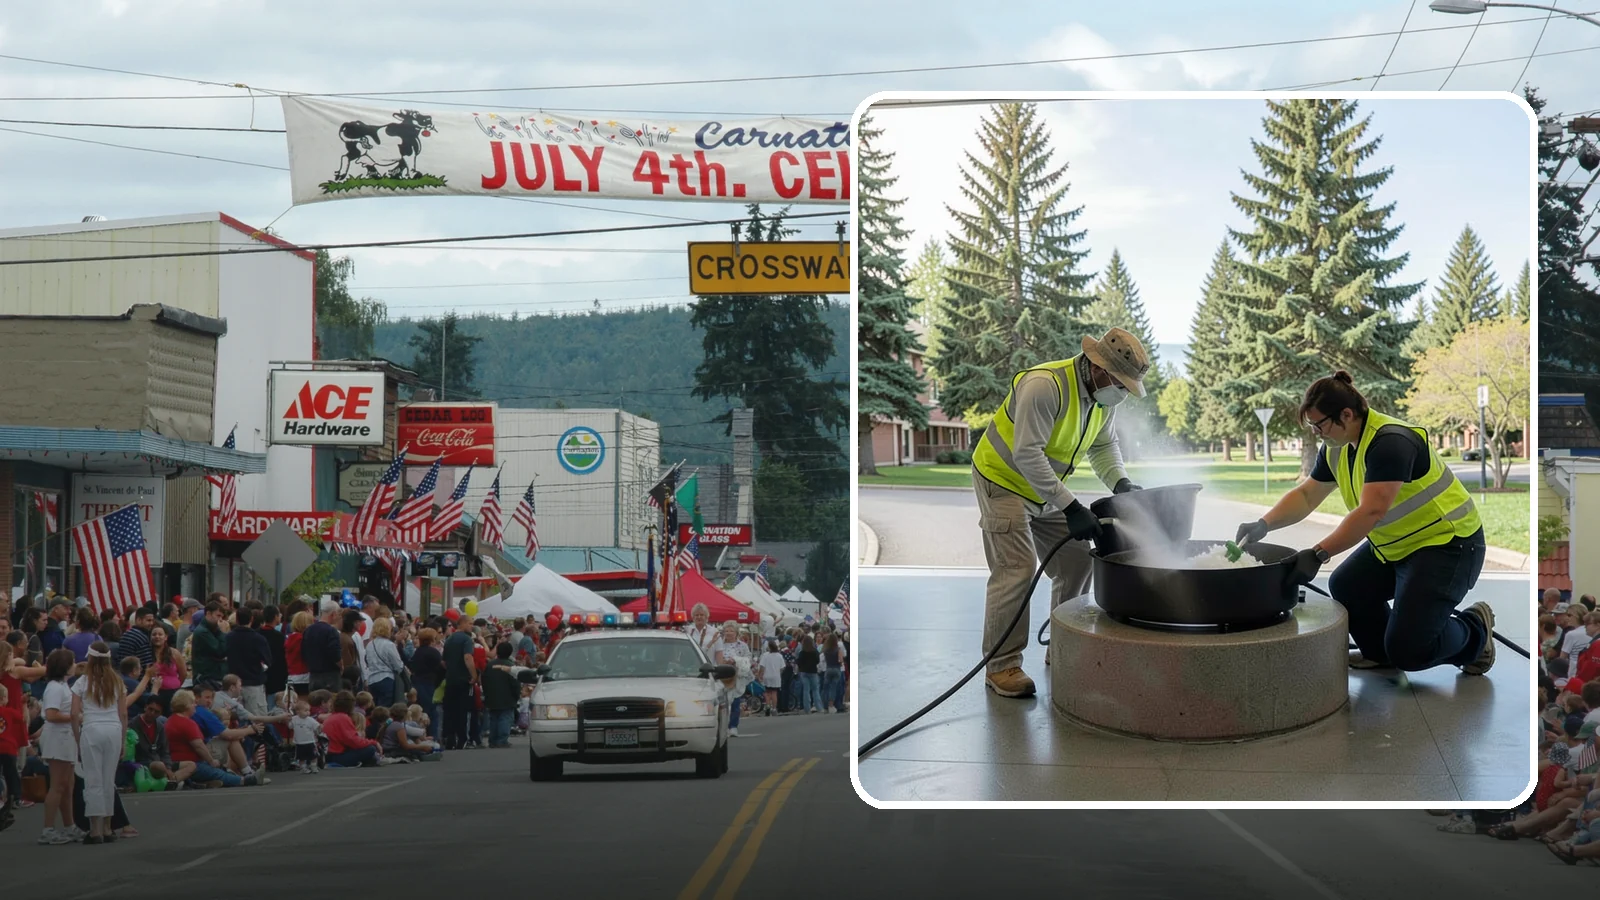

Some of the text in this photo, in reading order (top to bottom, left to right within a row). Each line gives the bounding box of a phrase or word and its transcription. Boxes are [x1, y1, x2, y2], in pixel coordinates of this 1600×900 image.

[695, 121, 849, 150] Carnat
[481, 141, 604, 192] JULY
[632, 150, 746, 198] 4th.
[697, 254, 849, 280] CROSSWA
[283, 380, 373, 419] ACE
[406, 409, 452, 422] CEDAR
[284, 421, 370, 436] Hardware
[353, 467, 385, 479] Simpl
[96, 485, 124, 494] Vincent
[126, 486, 136, 494] de
[138, 486, 155, 495] Paul
[688, 526, 741, 535] CRNATION
[699, 535, 730, 543] GLASS
